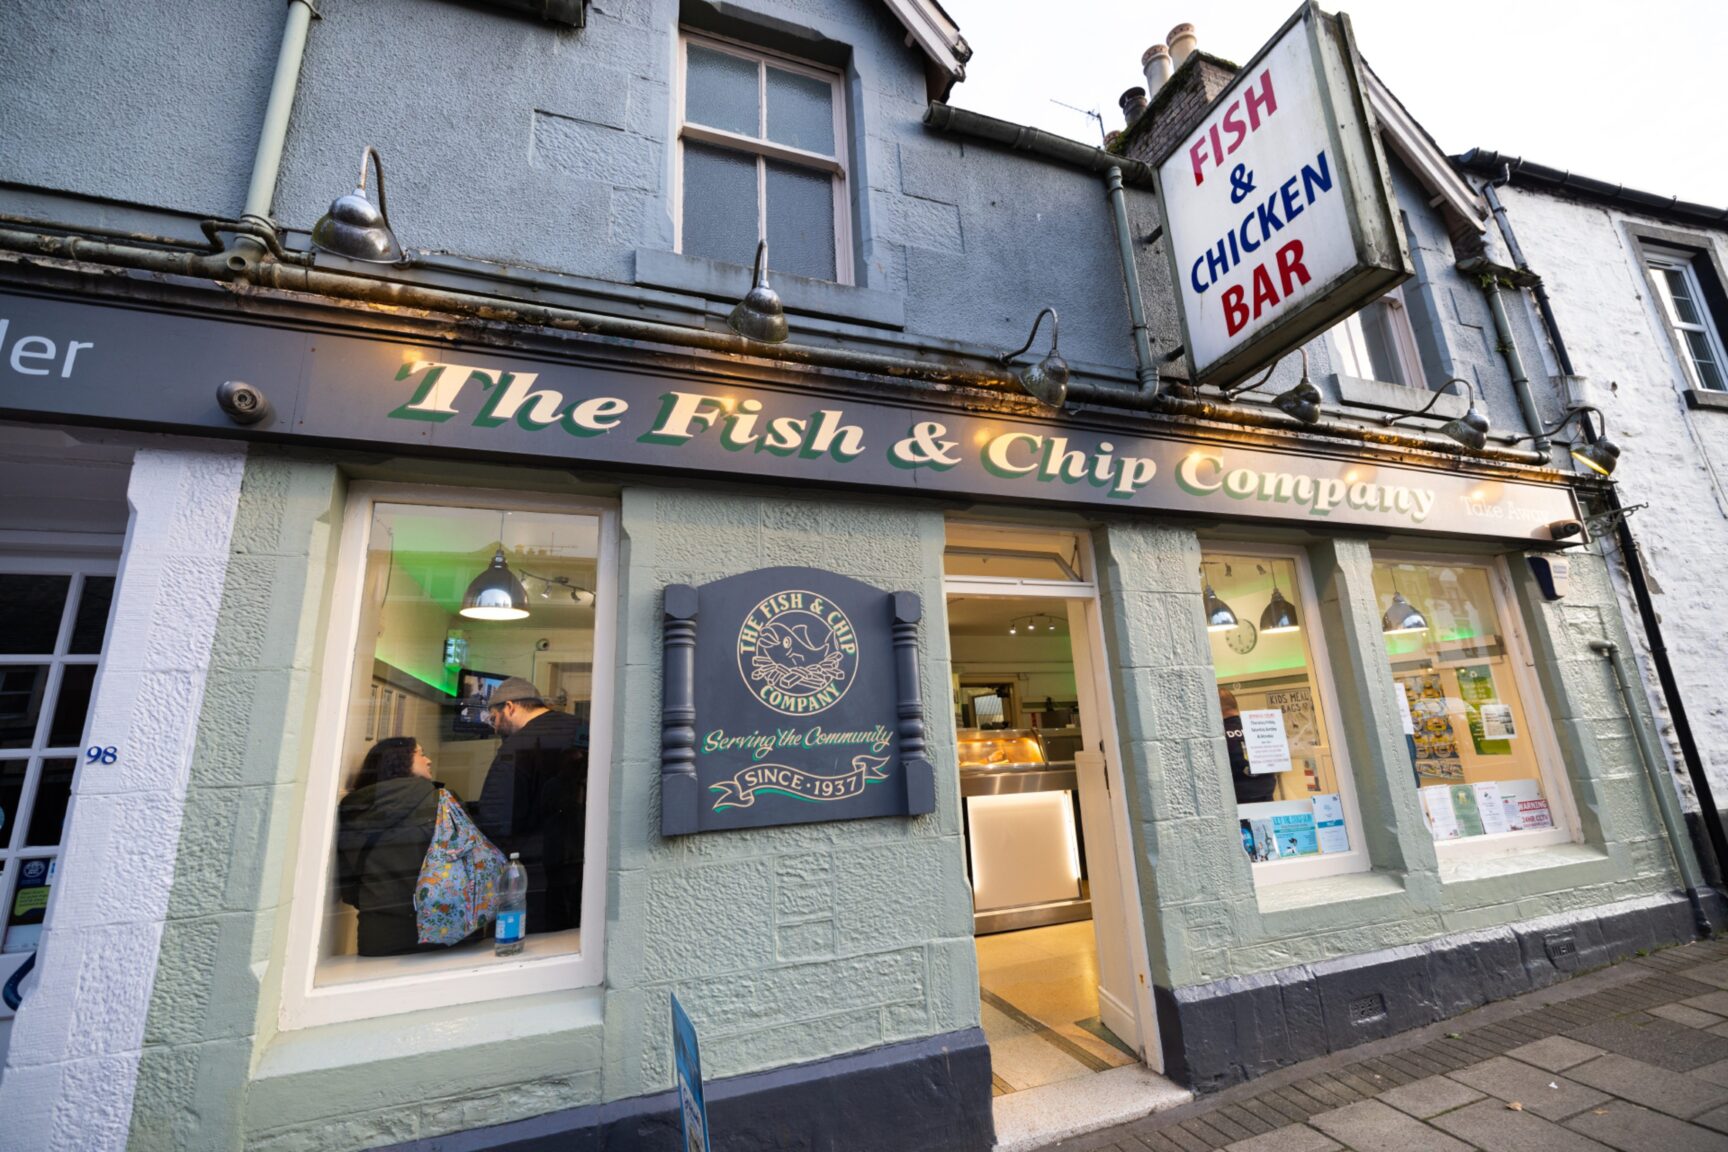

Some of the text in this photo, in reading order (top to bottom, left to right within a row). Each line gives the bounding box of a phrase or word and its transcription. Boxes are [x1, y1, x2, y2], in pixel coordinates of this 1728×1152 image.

[1189, 68, 1278, 187] FISH
[1230, 162, 1257, 204] &
[1191, 150, 1333, 294] CHICKEN
[1221, 239, 1312, 338] BAR
[388, 360, 1435, 523] The Fish & Chip Company
[1460, 495, 1504, 517] Take
[740, 593, 856, 656] THE FISH & CHIP
[760, 682, 841, 712] COMPANY
[1270, 690, 1309, 705] KIDS MEAL
[1281, 703, 1301, 713] BAGS
[86, 746, 118, 765] 98
[702, 724, 894, 761] Serving the Community
[745, 768, 857, 796] SINCE 1937
